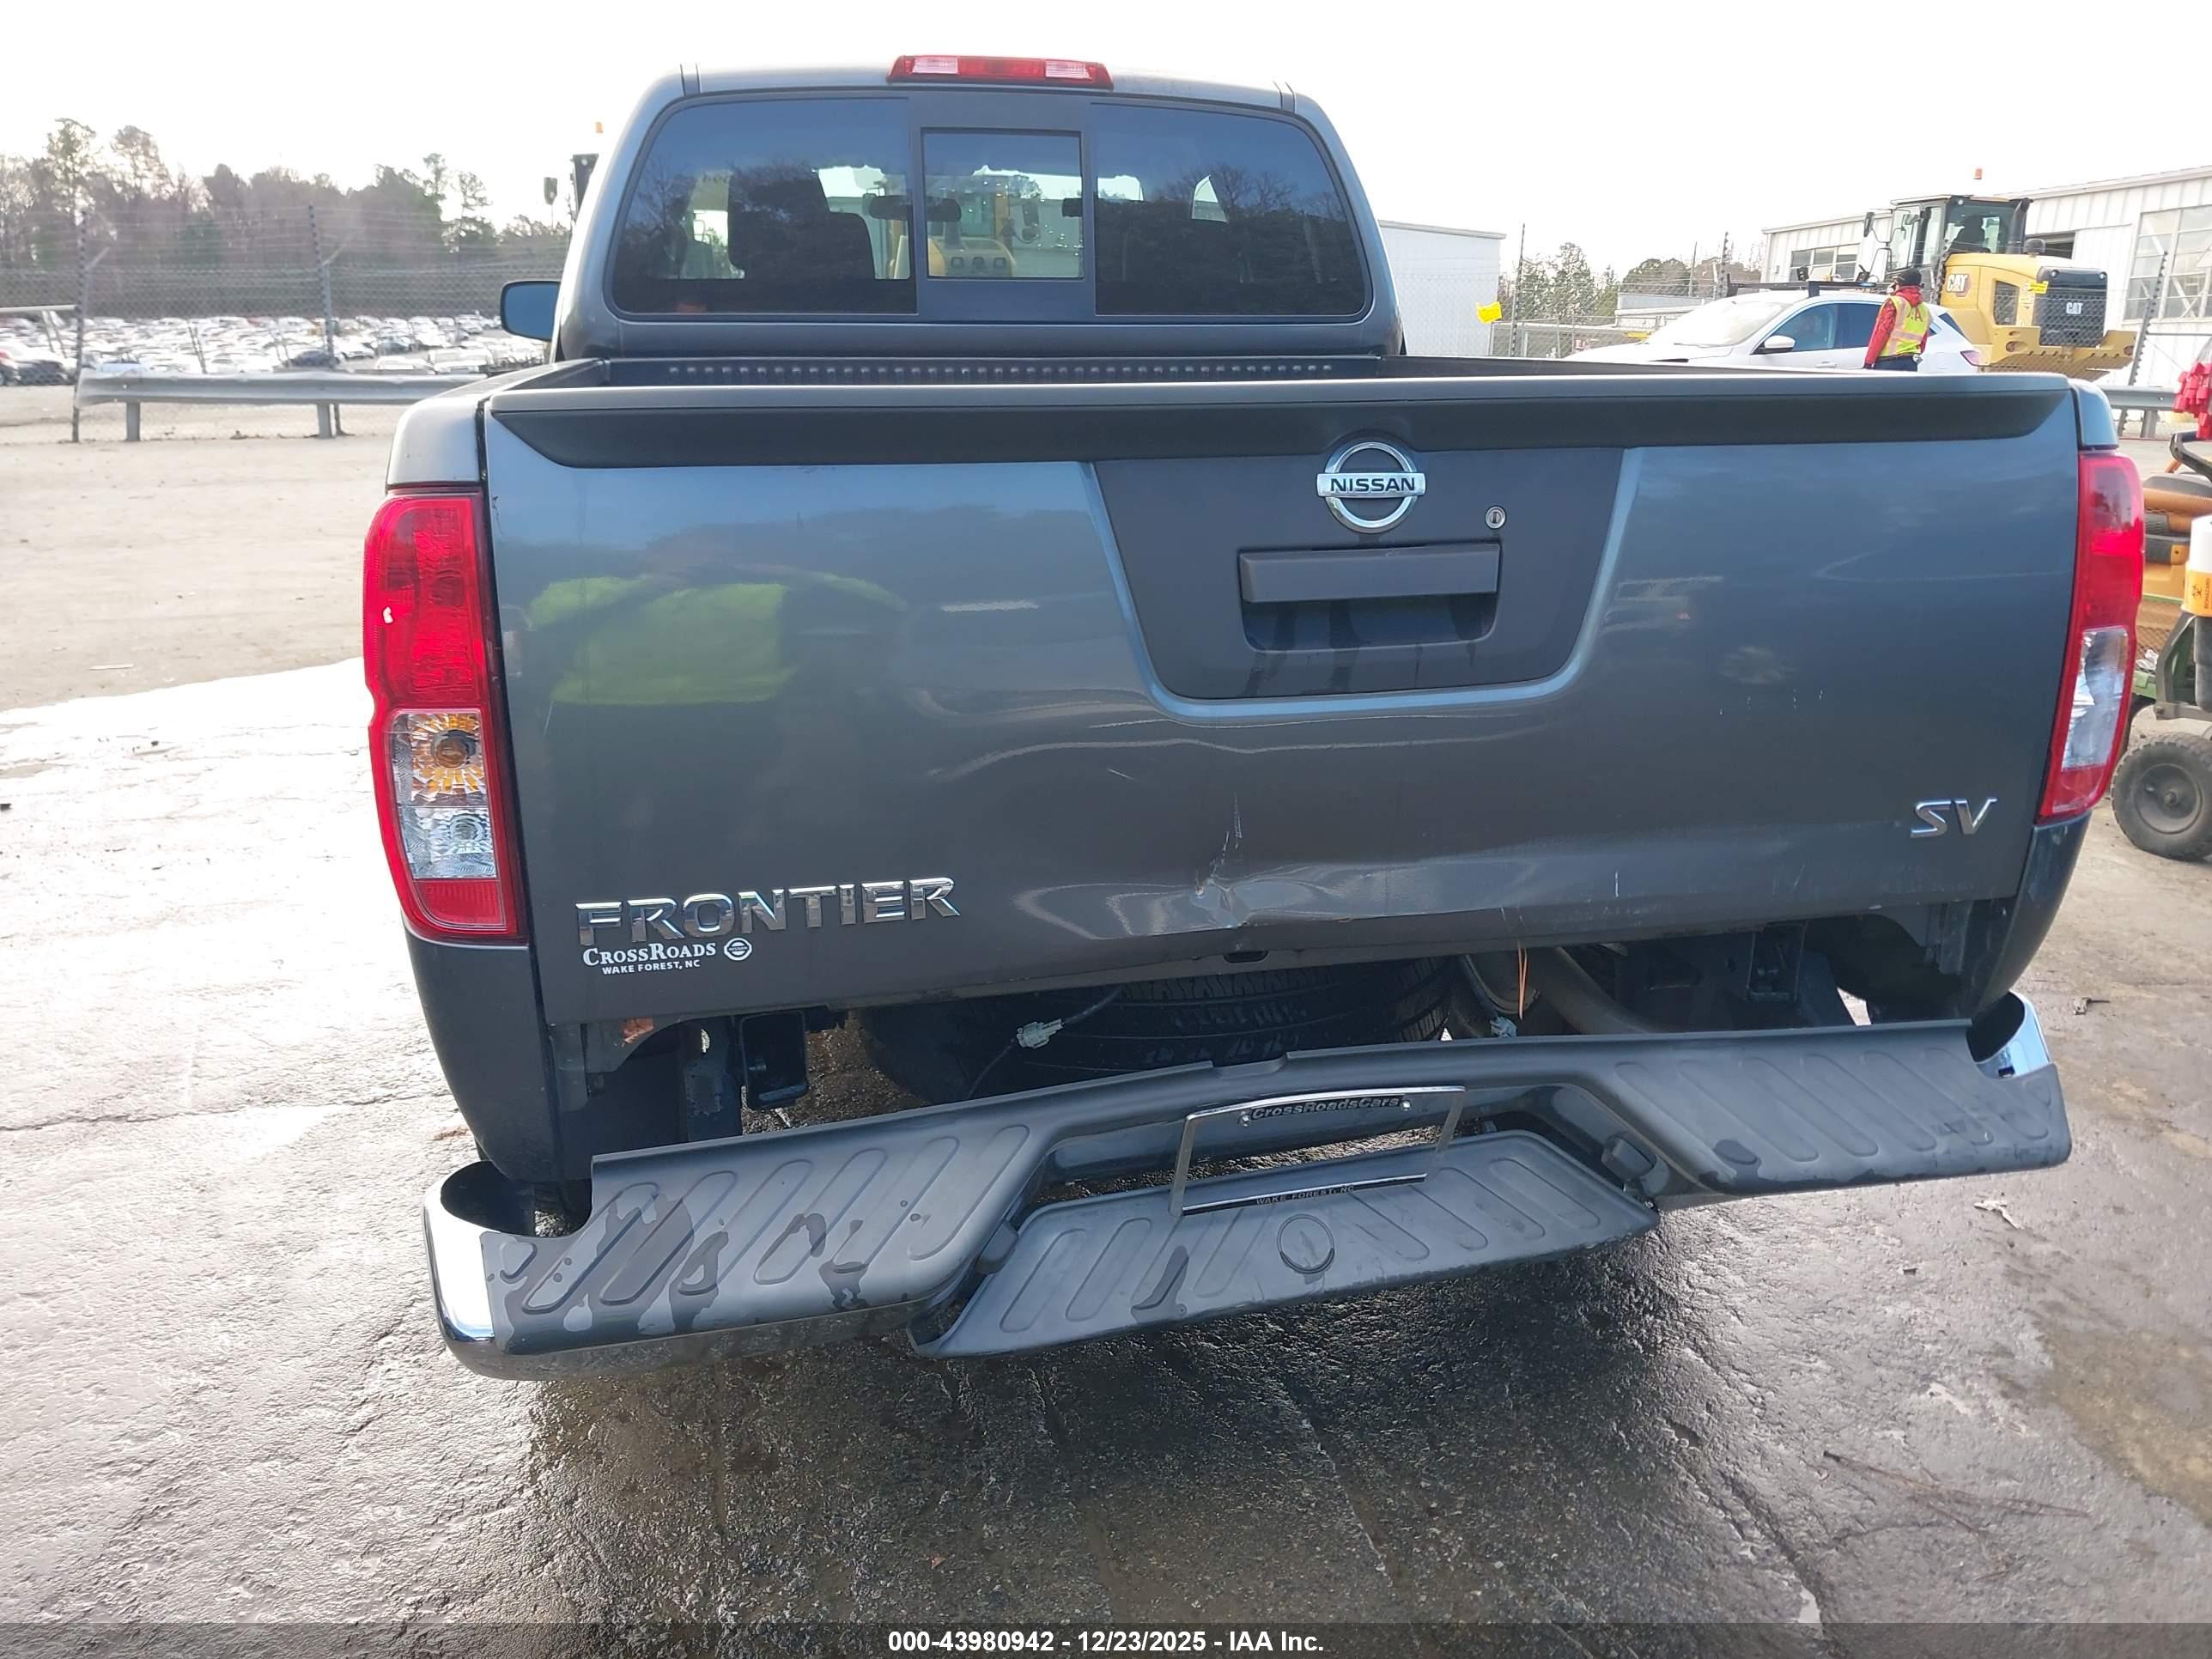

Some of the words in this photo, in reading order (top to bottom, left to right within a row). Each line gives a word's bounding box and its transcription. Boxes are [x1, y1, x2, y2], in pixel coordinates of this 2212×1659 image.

[1947, 274, 1968, 292] CAT
[2065, 301, 2084, 315] CAT
[1330, 477, 1415, 492] NISSAN
[1909, 799, 1998, 838] SV
[575, 877, 962, 946] FRONTIER
[602, 963, 635, 975] WAKE
[638, 961, 683, 972] FOREST,
[1252, 1097, 1400, 1120] CrossRoadsCars
[1256, 1195, 1285, 1206] WAKE
